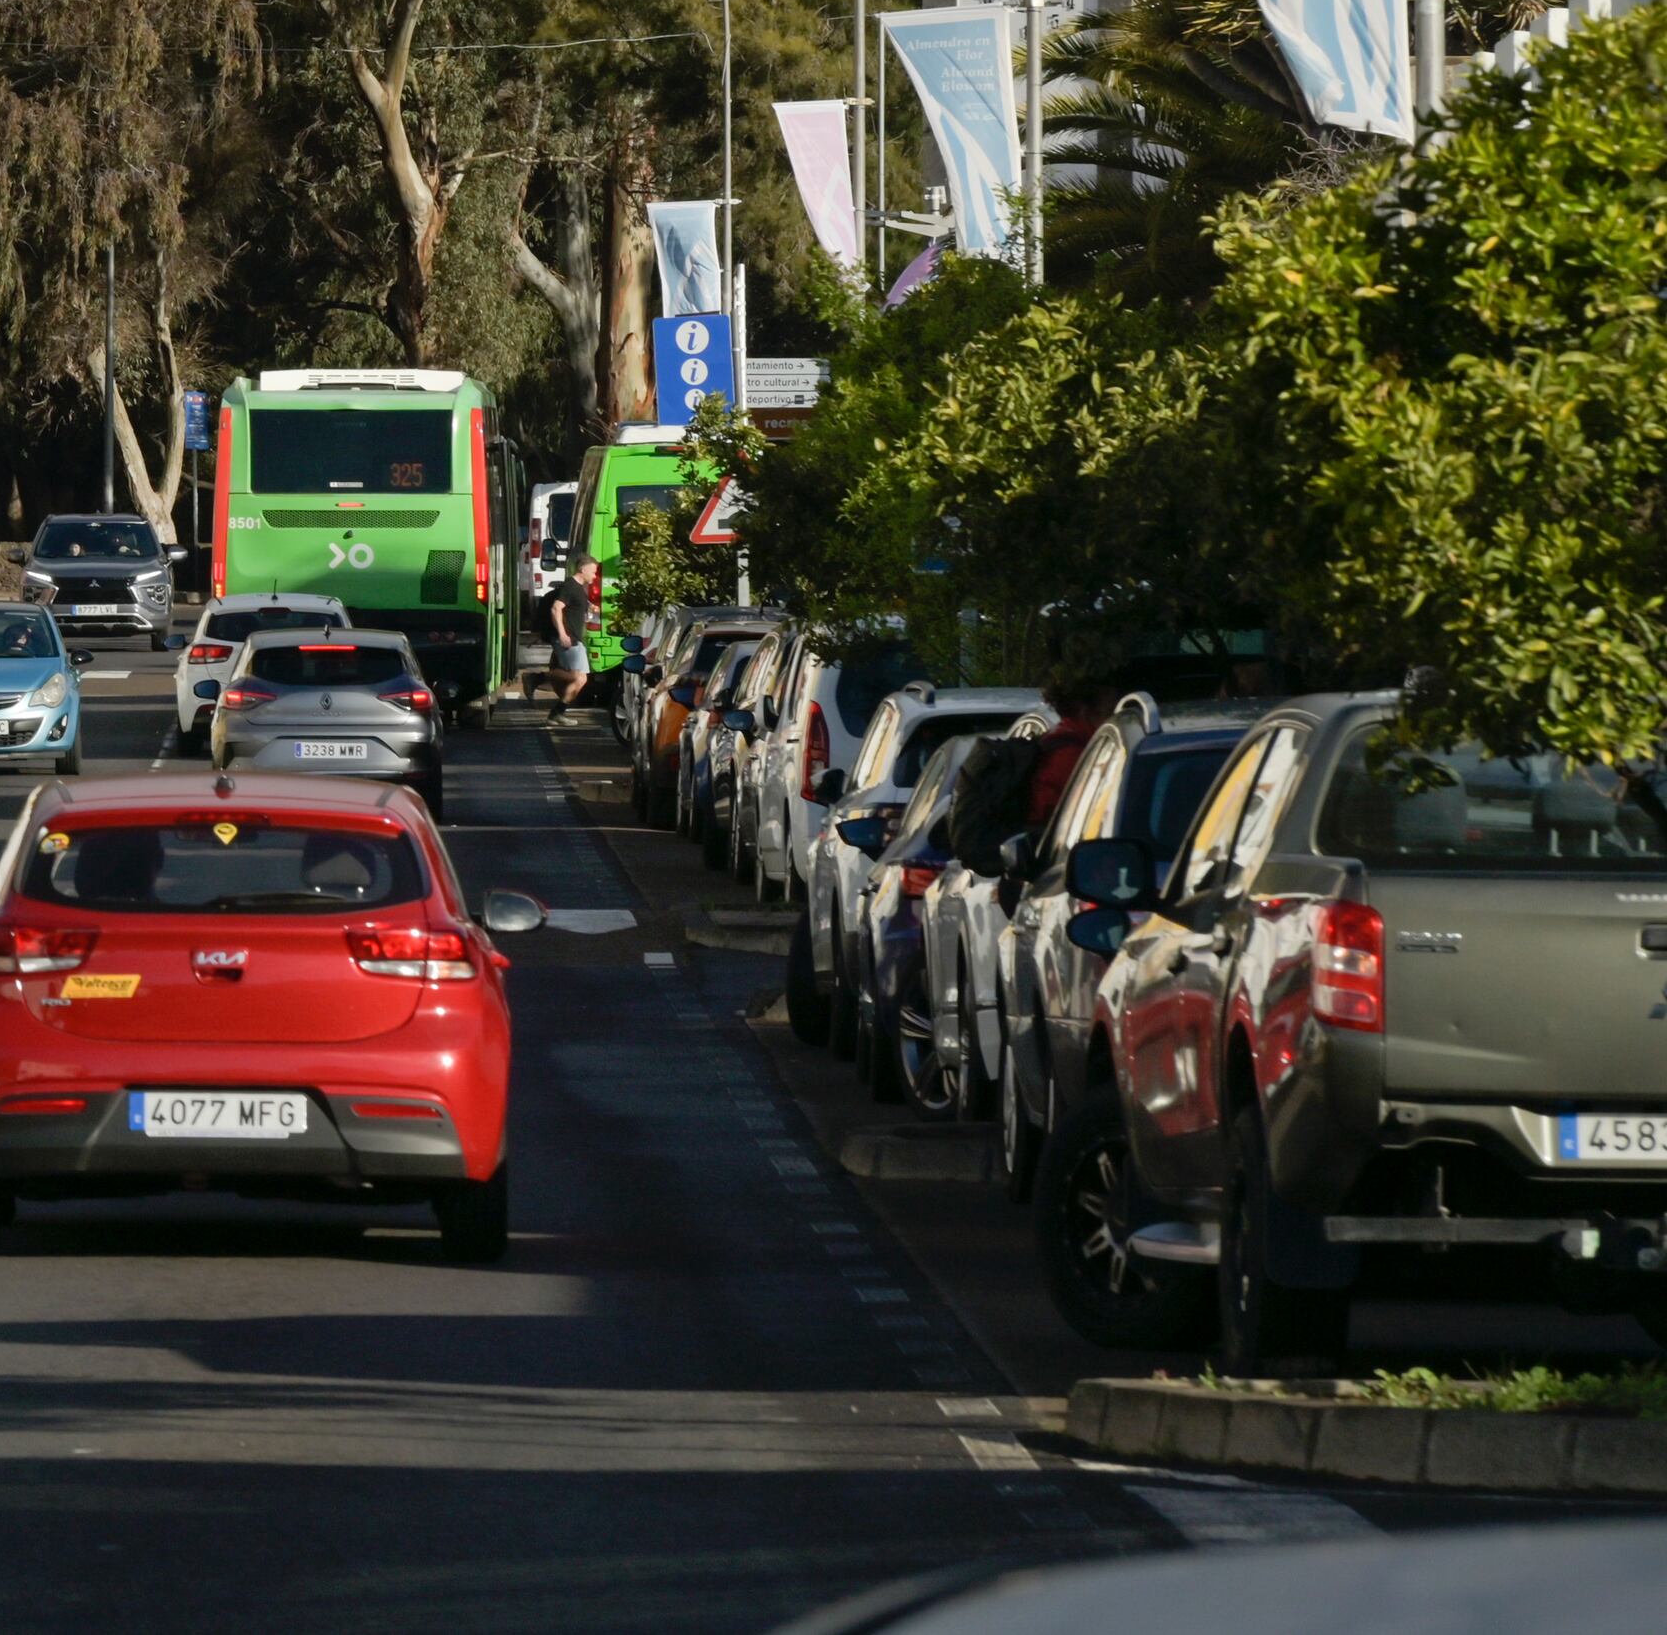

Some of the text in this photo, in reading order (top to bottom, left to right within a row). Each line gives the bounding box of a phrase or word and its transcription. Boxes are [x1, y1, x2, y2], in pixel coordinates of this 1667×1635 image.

[905, 37, 990, 52] Almendro en
[941, 65, 993, 78] Almond
[763, 378, 800, 387] cultural
[746, 395, 790, 404] deportivo
[390, 463, 423, 487] 325
[228, 516, 262, 530] 8501
[304, 745, 363, 757] 3238 MWR
[151, 1098, 295, 1127] 4077 MFG
